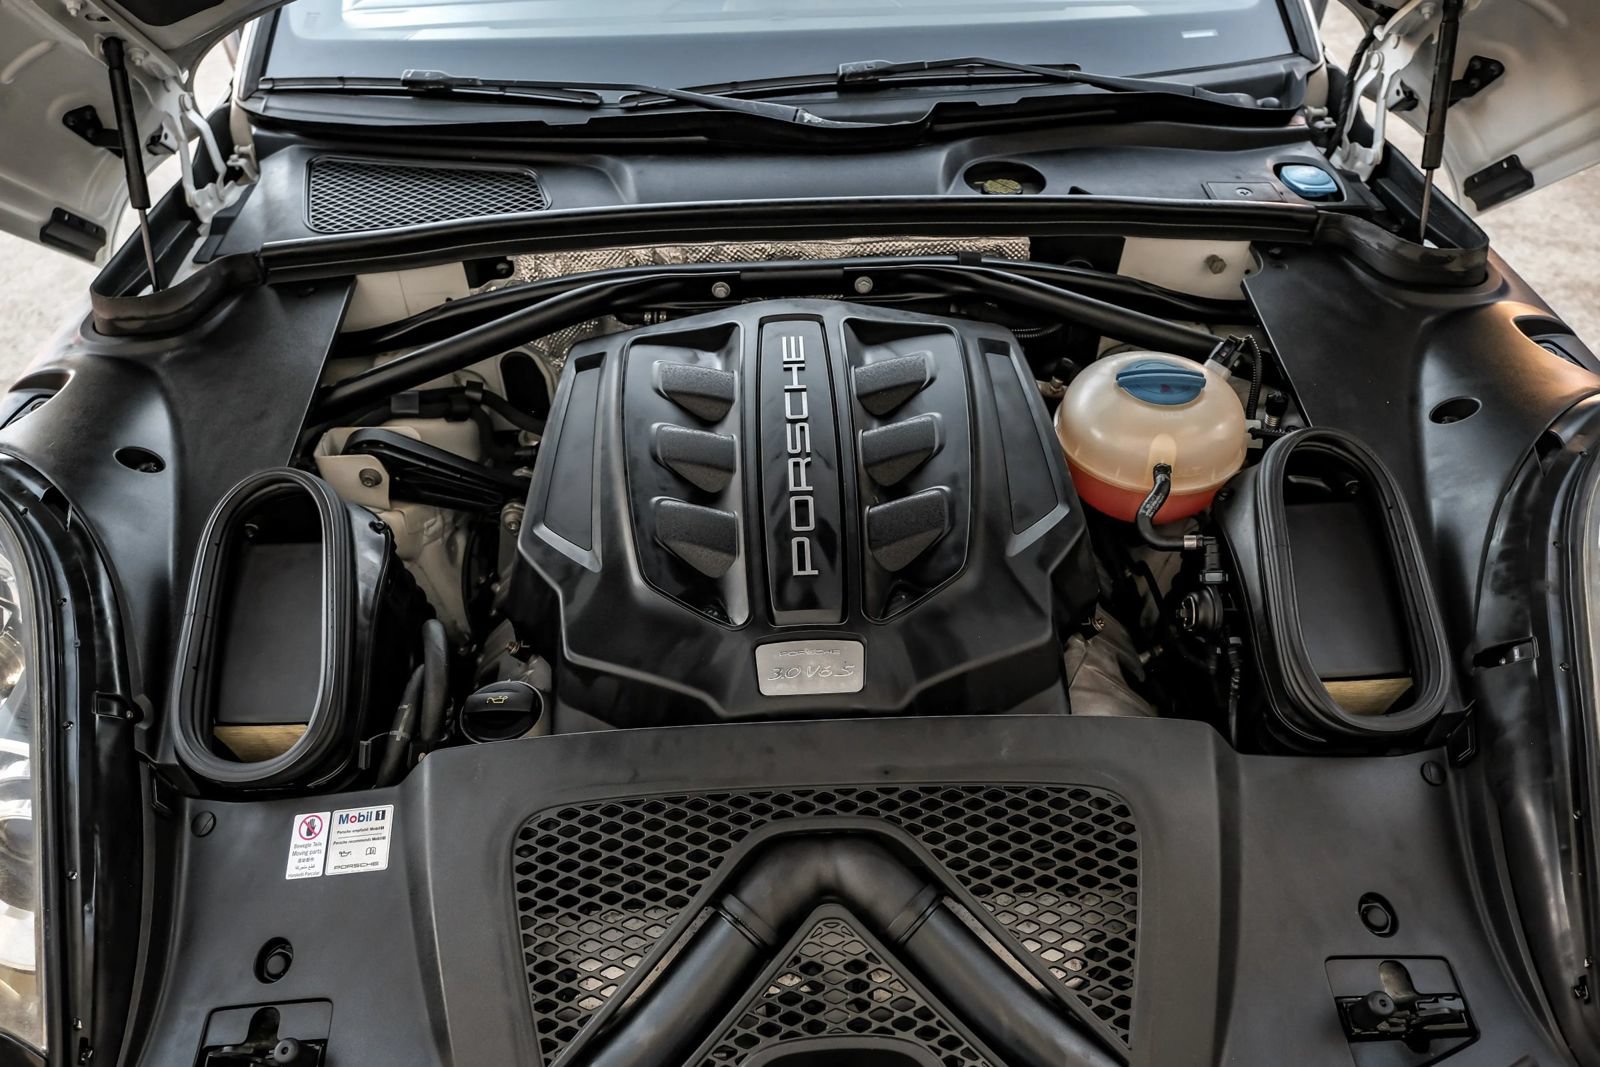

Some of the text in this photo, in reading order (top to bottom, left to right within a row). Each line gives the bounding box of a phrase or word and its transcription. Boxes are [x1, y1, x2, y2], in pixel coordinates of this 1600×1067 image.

[782, 336, 819, 576] PORSCHE
[778, 648, 841, 657] PORSCHE
[768, 665, 856, 681] 3.0 V6 S
[338, 811, 373, 825] Mobil
[333, 861, 380, 870] PORSCHE
